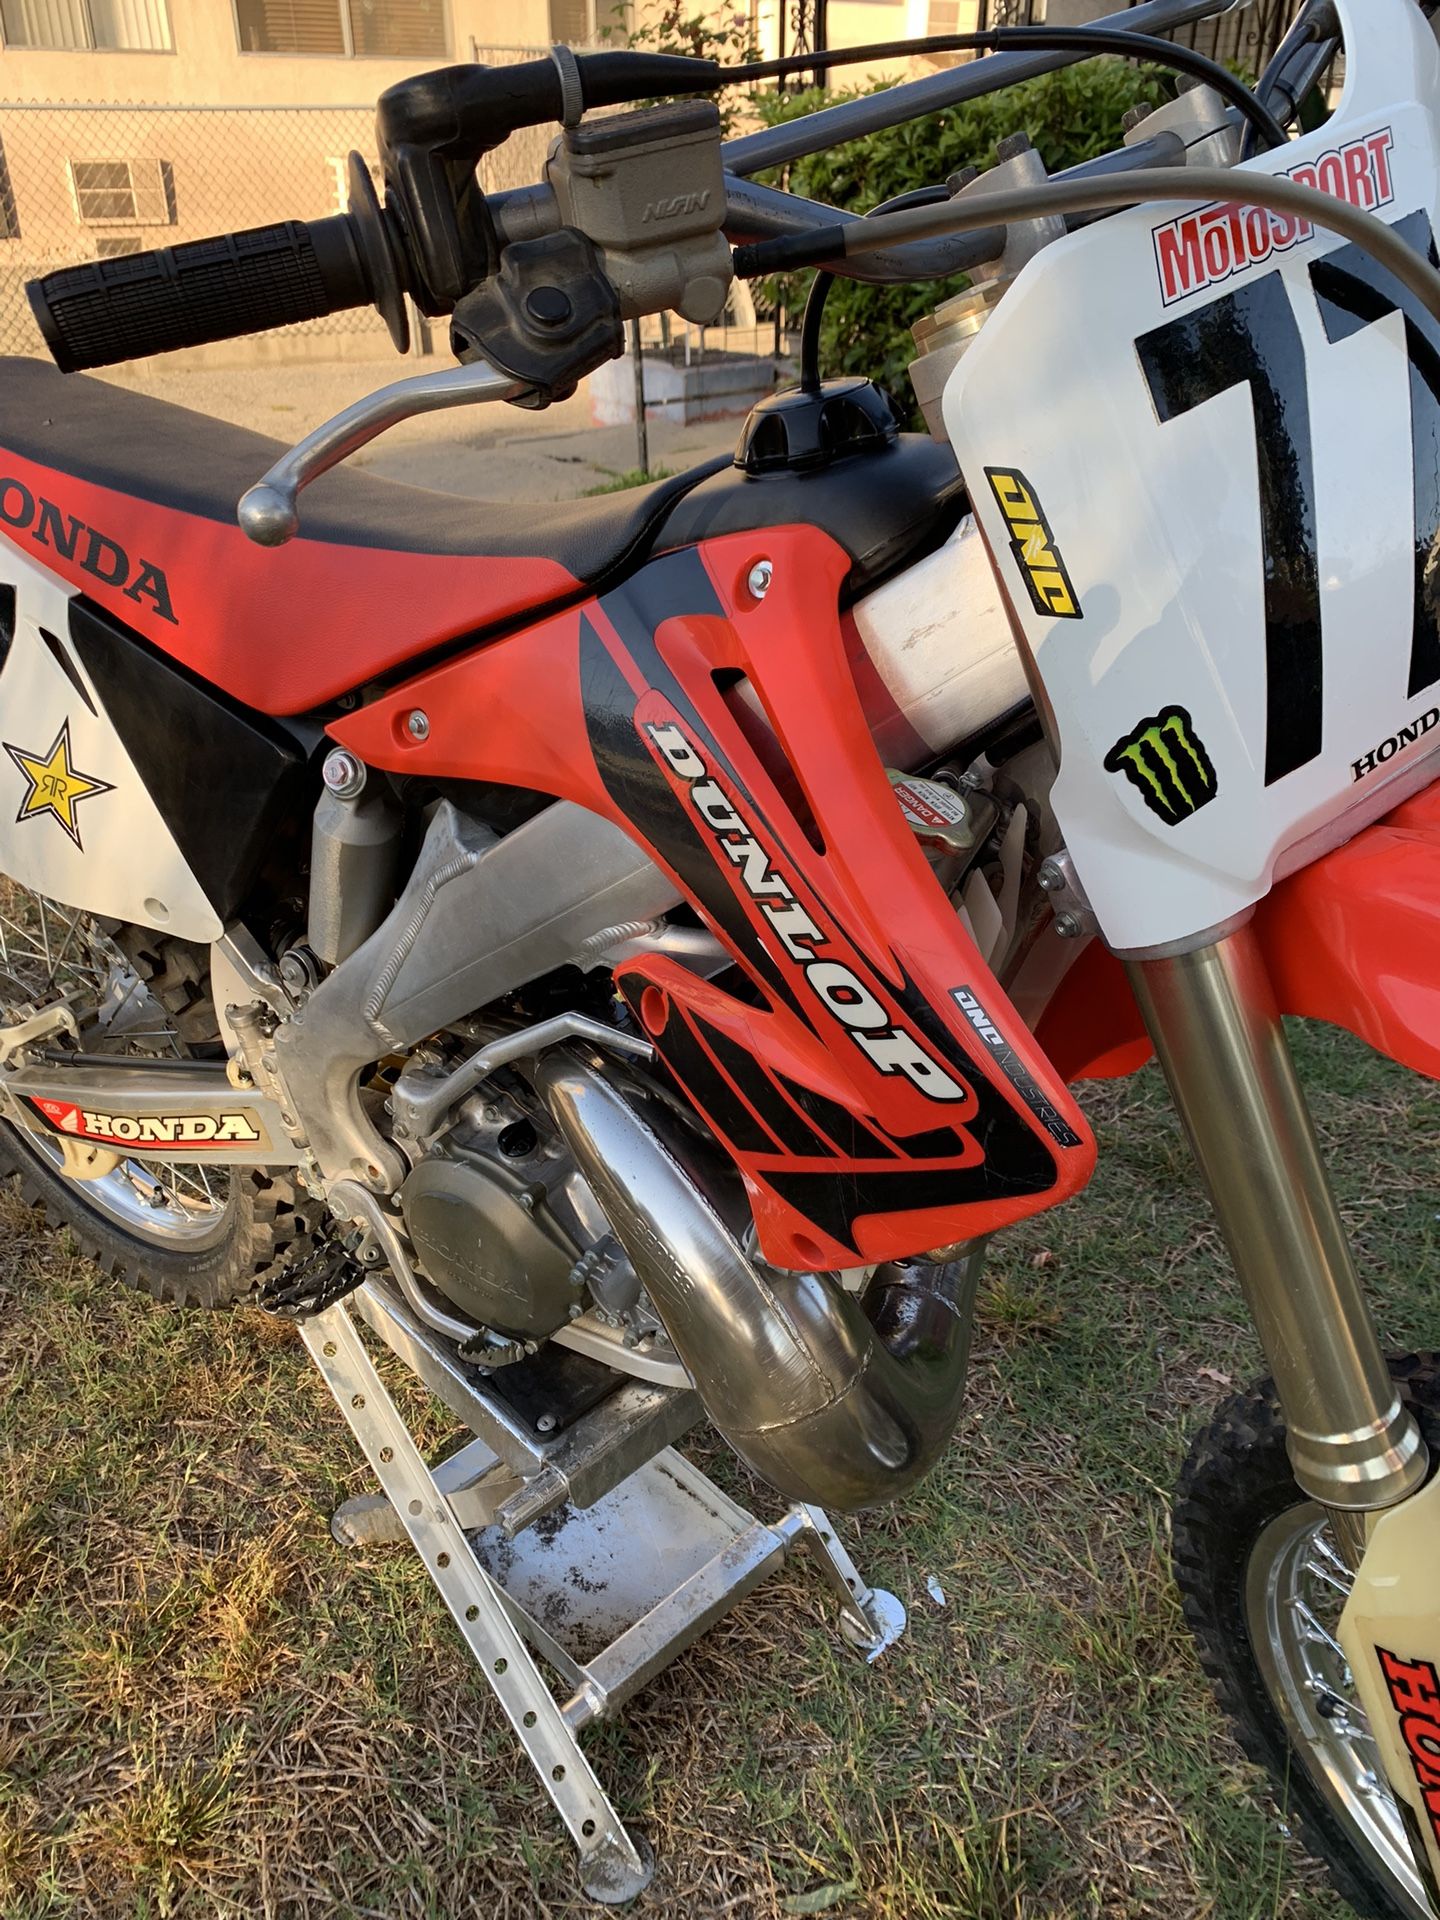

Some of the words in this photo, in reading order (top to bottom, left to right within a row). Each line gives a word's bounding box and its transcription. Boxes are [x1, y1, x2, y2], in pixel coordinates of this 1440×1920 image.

[0, 477, 179, 626] ONDA
[1351, 707, 1440, 783] HOND
[894, 786, 933, 817] DANGER
[642, 721, 967, 1103] DUNLOP
[82, 1111, 260, 1142] HONDA
[995, 1044, 1078, 1145] INDUSTRIES
